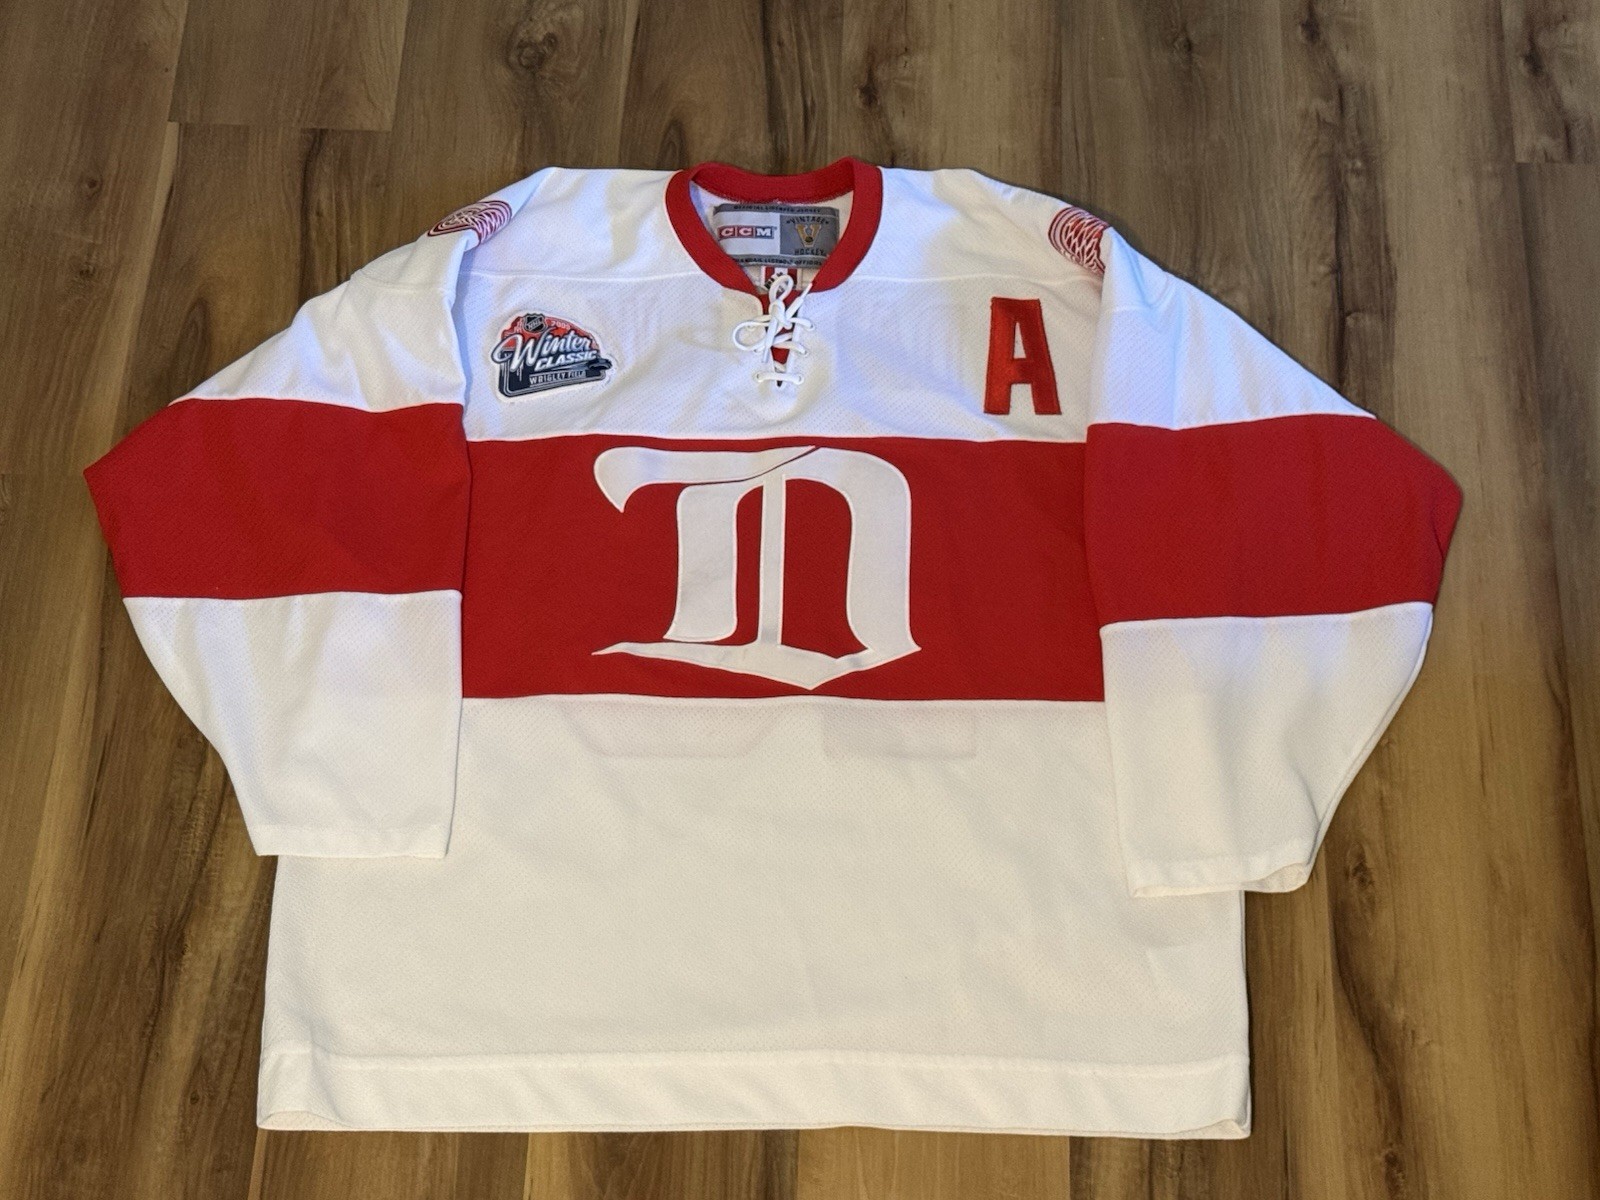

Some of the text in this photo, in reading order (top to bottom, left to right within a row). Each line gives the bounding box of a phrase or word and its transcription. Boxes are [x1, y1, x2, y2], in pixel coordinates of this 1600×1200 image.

[789, 216, 826, 224] VINTAGE
[719, 226, 773, 239] CCM
[794, 248, 825, 256] HOCKEY
[492, 326, 591, 373] Winter
[983, 296, 1062, 415] A
[534, 350, 597, 372] CLASSIC
[529, 373, 566, 385] WRIGLEY
[592, 444, 922, 691] D
